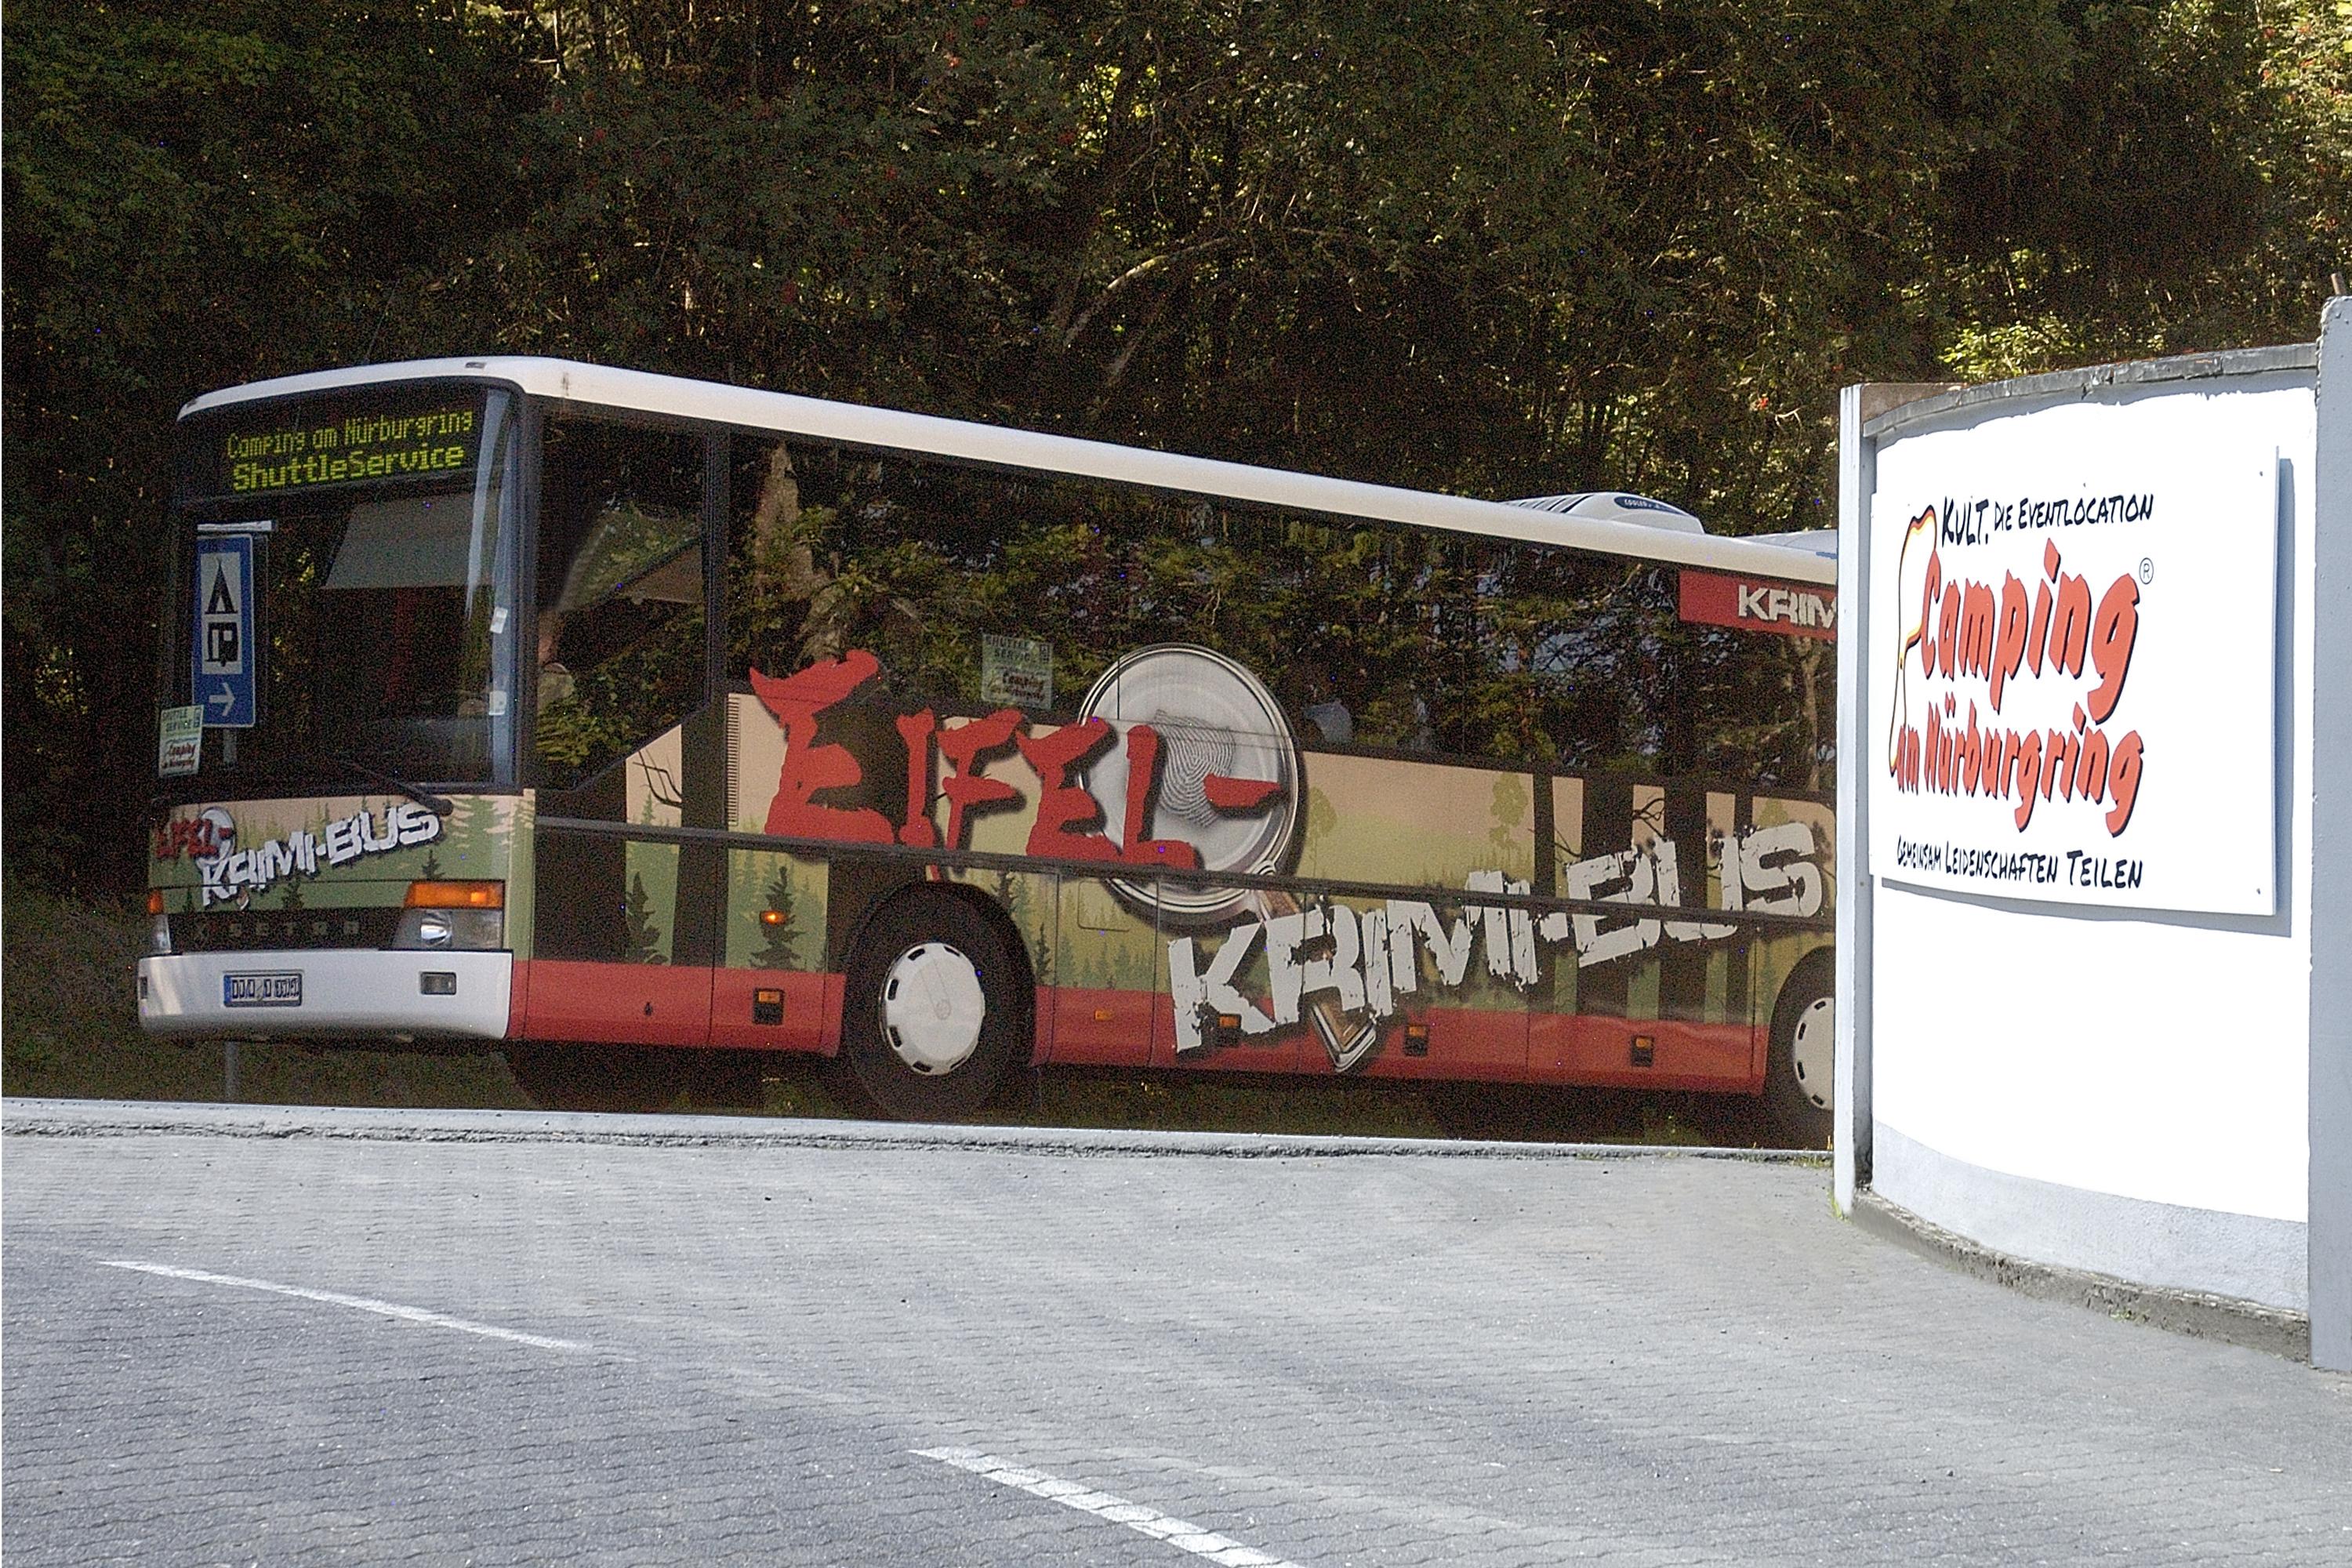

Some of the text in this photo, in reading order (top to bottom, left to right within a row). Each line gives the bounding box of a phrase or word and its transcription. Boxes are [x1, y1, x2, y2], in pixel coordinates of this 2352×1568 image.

[227, 409, 474, 459] Camping am Nürburgring
[1941, 494, 2154, 548] KULT. DIE EVENTLOCATION
[1921, 537, 2140, 726] Camping
[1896, 691, 2144, 838] am Nürburgring
[1896, 834, 2143, 889] GEMEINSAM LEIDENSCHAFTEN TEILEN
[1167, 820, 1824, 1054] KRIMI-BUS
